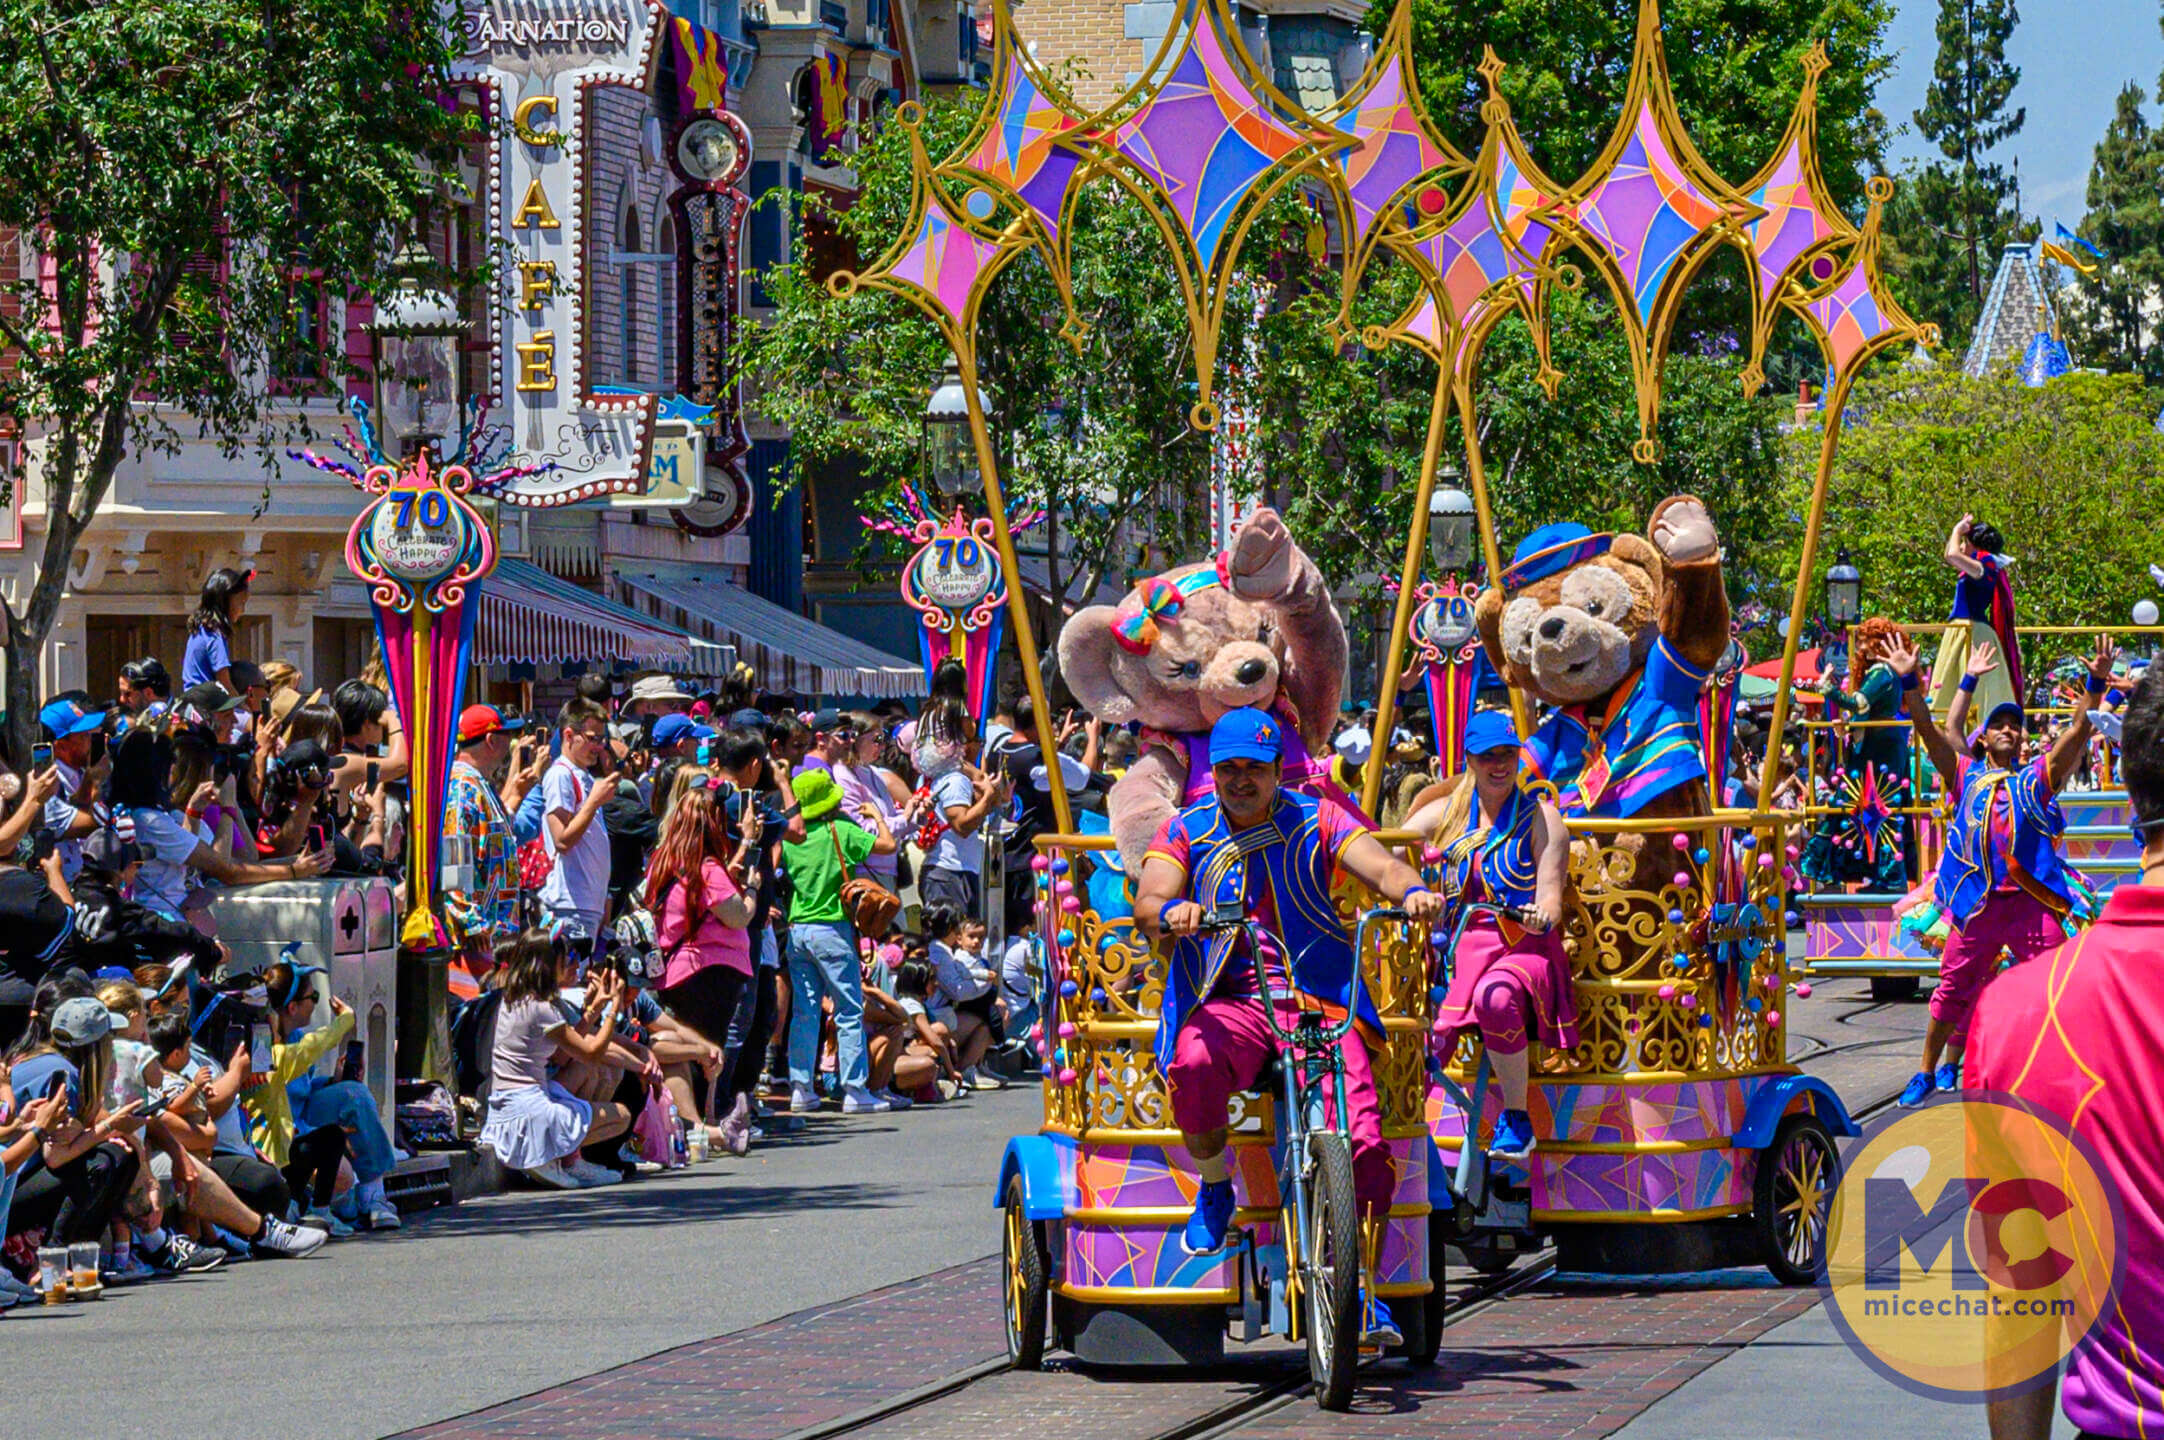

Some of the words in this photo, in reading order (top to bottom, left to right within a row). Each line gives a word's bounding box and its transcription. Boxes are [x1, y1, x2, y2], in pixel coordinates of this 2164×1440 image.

[446, 11, 628, 55] CARNATION
[512, 95, 561, 392] CAFÉ
[388, 489, 450, 529] 70
[400, 547, 437, 560] HAPPY
[934, 537, 980, 568] 70
[1433, 596, 1467, 617] 70
